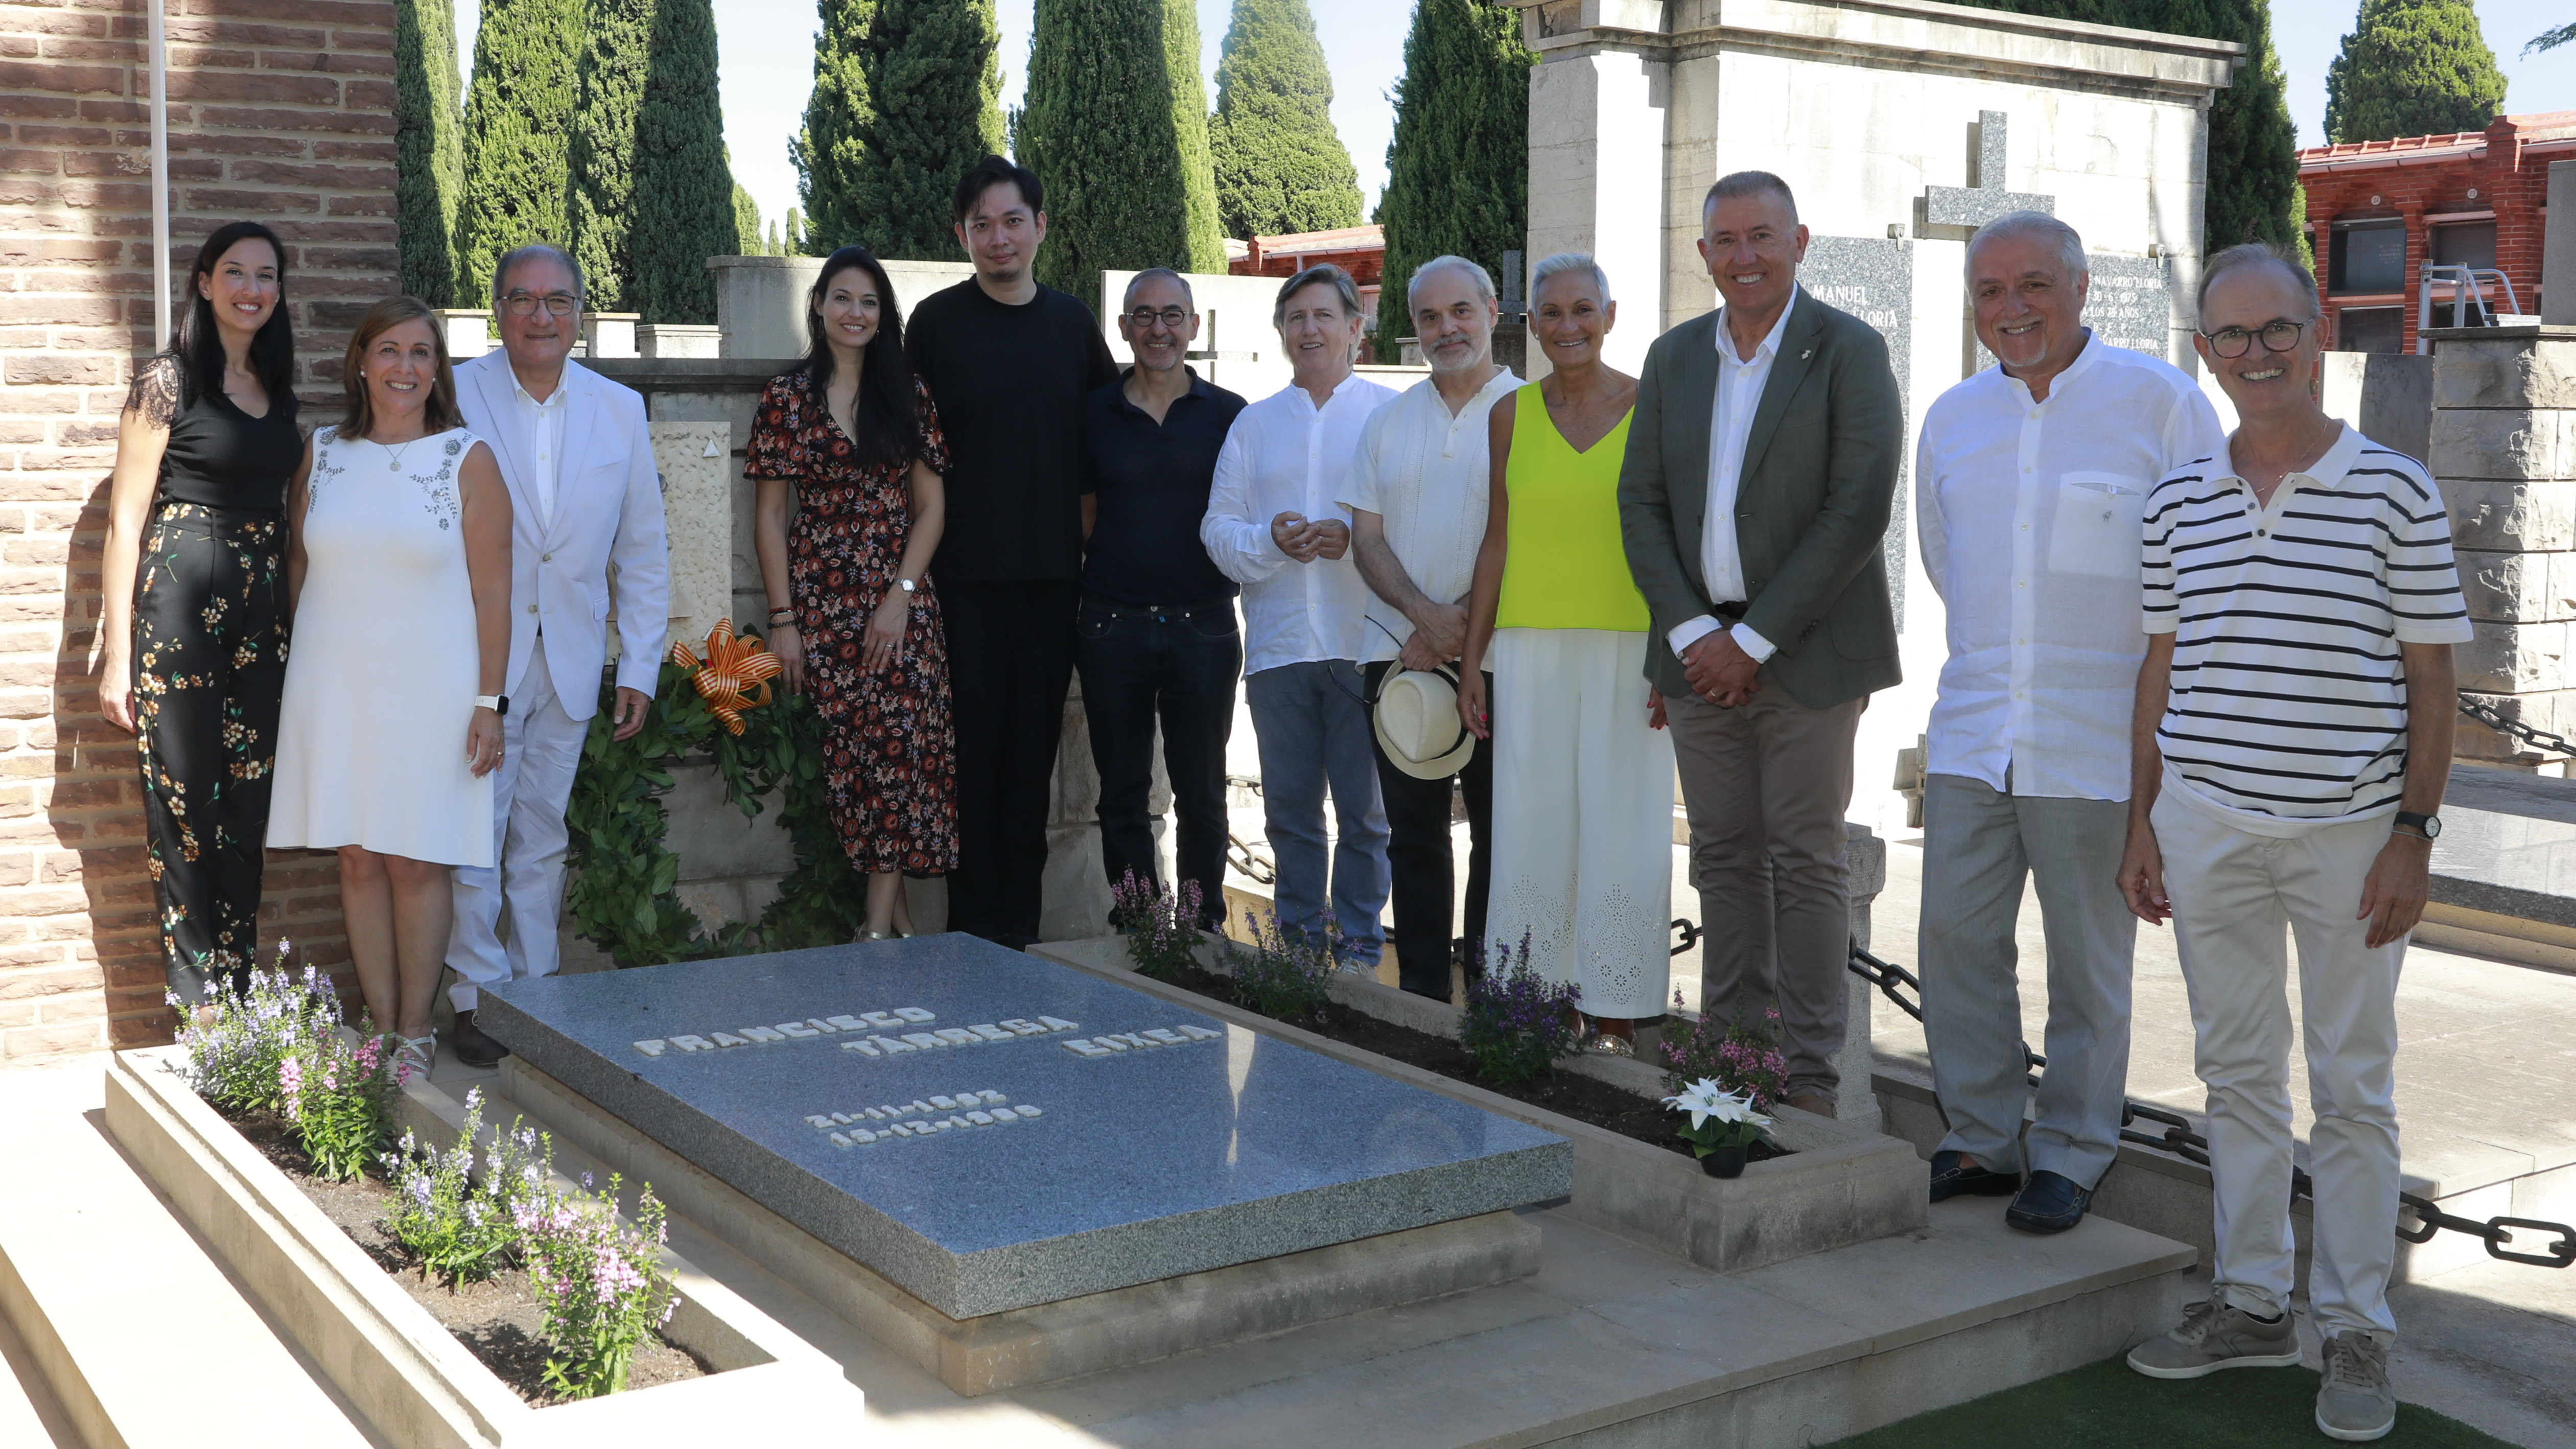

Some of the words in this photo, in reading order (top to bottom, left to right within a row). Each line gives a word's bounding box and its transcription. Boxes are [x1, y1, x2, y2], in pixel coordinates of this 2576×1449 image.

[1813, 285, 1868, 303] MANUEL
[2095, 275, 2133, 287] NAVARRO
[2135, 277, 2163, 289] LLORIA
[2090, 307, 2104, 317] LOS
[2119, 306, 2139, 318] AÑOS
[2102, 337, 2129, 348] VARRO
[2132, 338, 2159, 349] LLORIA
[633, 1007, 936, 1056] FRANCISCO
[1062, 1025, 1222, 1056] EIXEA
[804, 1090, 1007, 1129] 21-11-1852
[830, 1105, 1042, 1147] 15-12-1909
